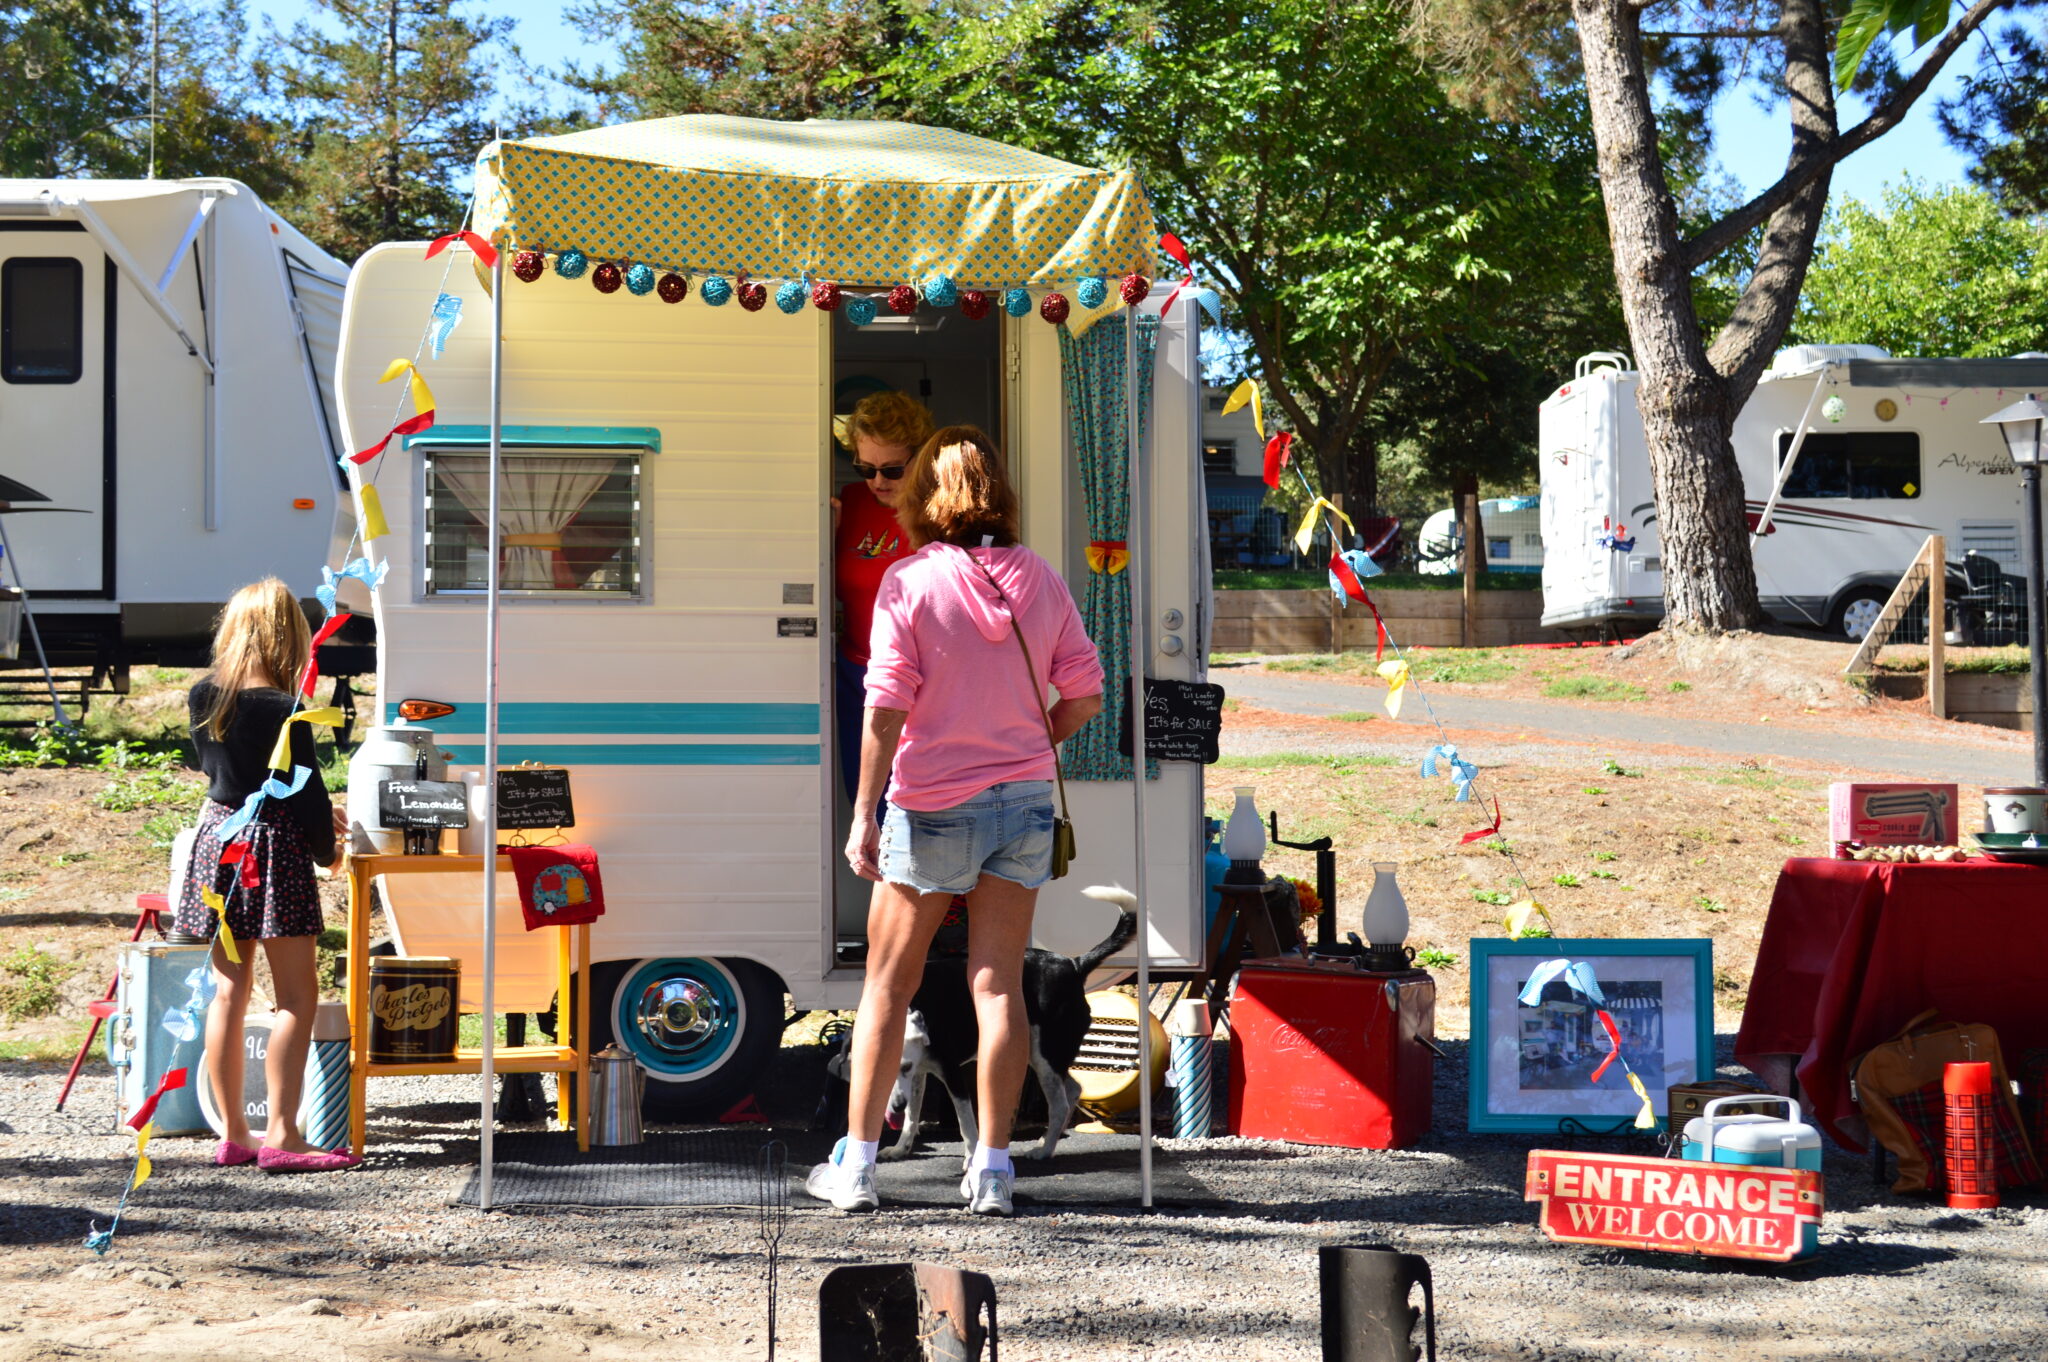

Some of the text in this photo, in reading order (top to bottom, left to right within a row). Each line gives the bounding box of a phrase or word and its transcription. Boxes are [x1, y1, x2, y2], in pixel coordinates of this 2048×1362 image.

[1978, 467, 2015, 475] ASPEN
[1195, 691, 1216, 699] Loafer
[1170, 716, 1185, 729] for
[1188, 717, 1212, 730] SALE
[1168, 741, 1183, 749] white
[388, 781, 419, 794] Free
[527, 787, 540, 799] for
[399, 795, 466, 811] Lemonade
[375, 987, 431, 1014] Charles
[1554, 1164, 1796, 1215] ENTRANCE
[1565, 1202, 1782, 1249] WELCOME
